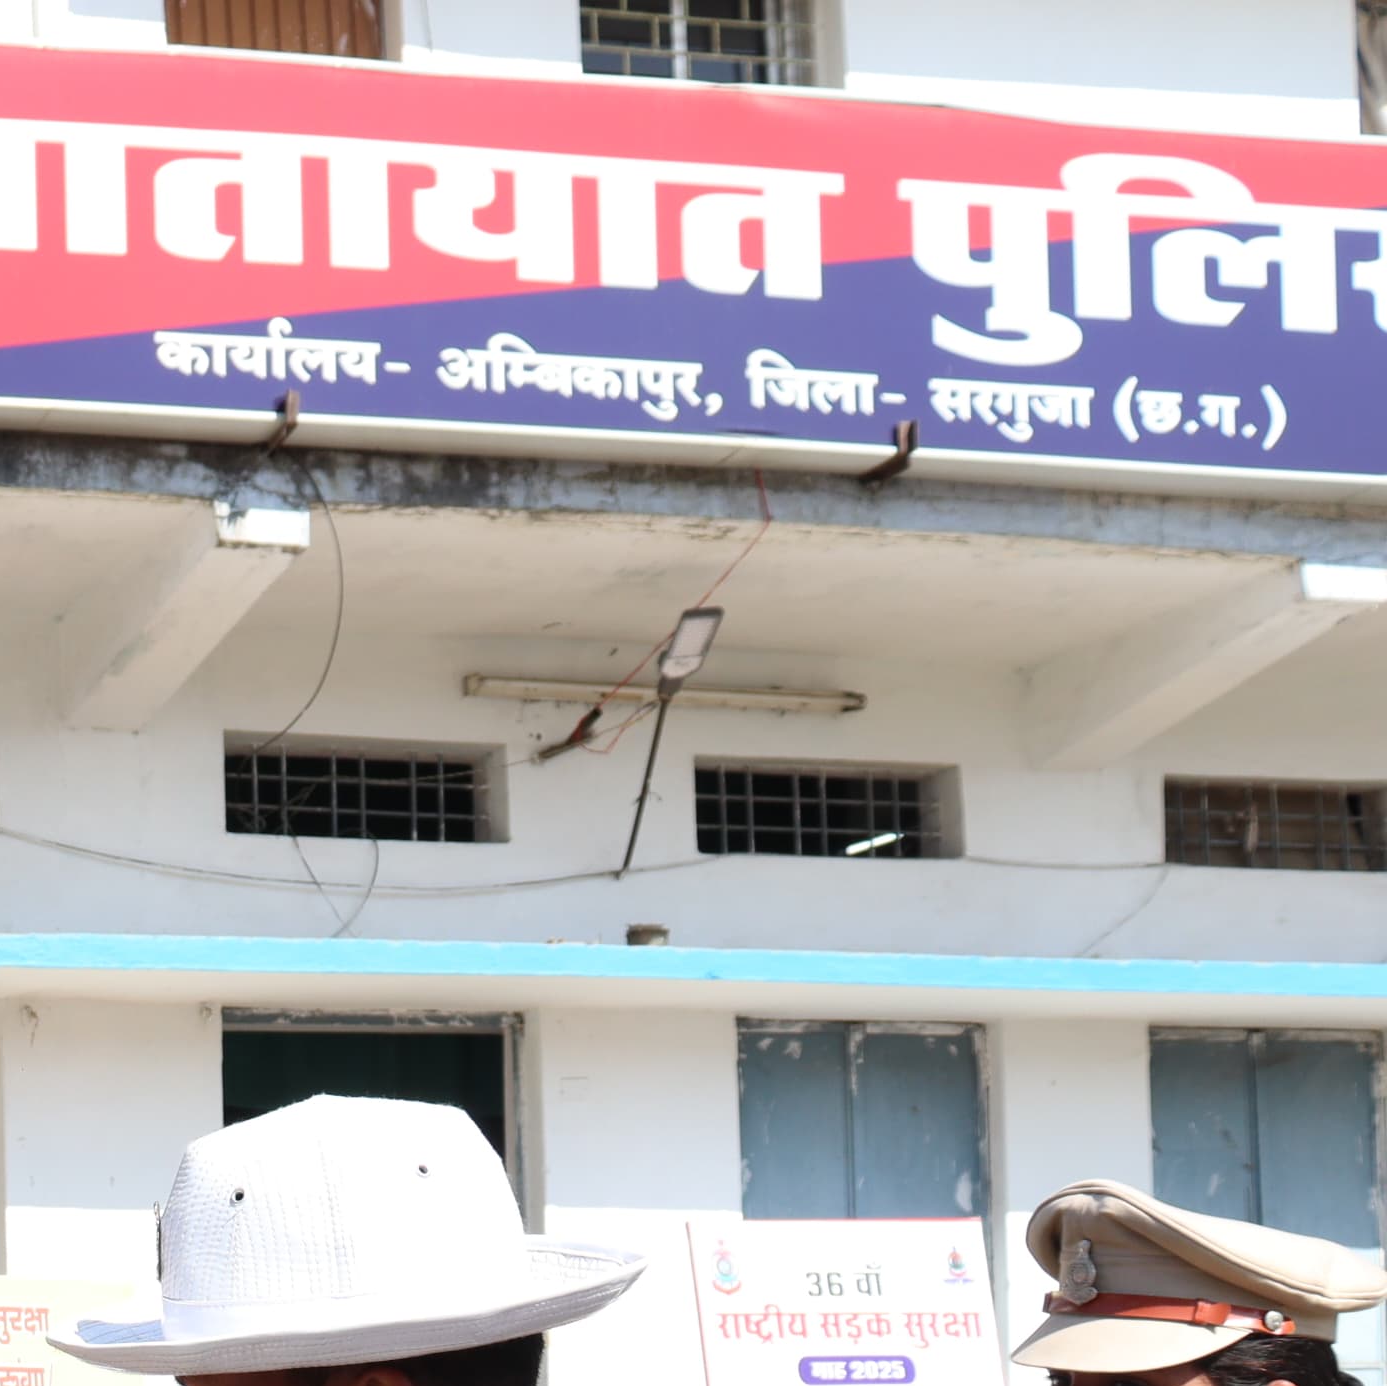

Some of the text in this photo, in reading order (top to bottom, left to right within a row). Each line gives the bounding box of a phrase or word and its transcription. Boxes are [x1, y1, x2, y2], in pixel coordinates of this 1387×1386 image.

[897, 153, 1387, 366] पुलि
[436, 332, 723, 421] अम्बिकापुर,
[928, 377, 1095, 442] सरगुजा
[1113, 375, 1287, 450] (छ.ग.)
[805, 1272, 843, 1297] 36
[716, 1304, 983, 1348] राष्ट्रीय सड़क सुरक्षा
[810, 1360, 906, 1380] माह 2025
